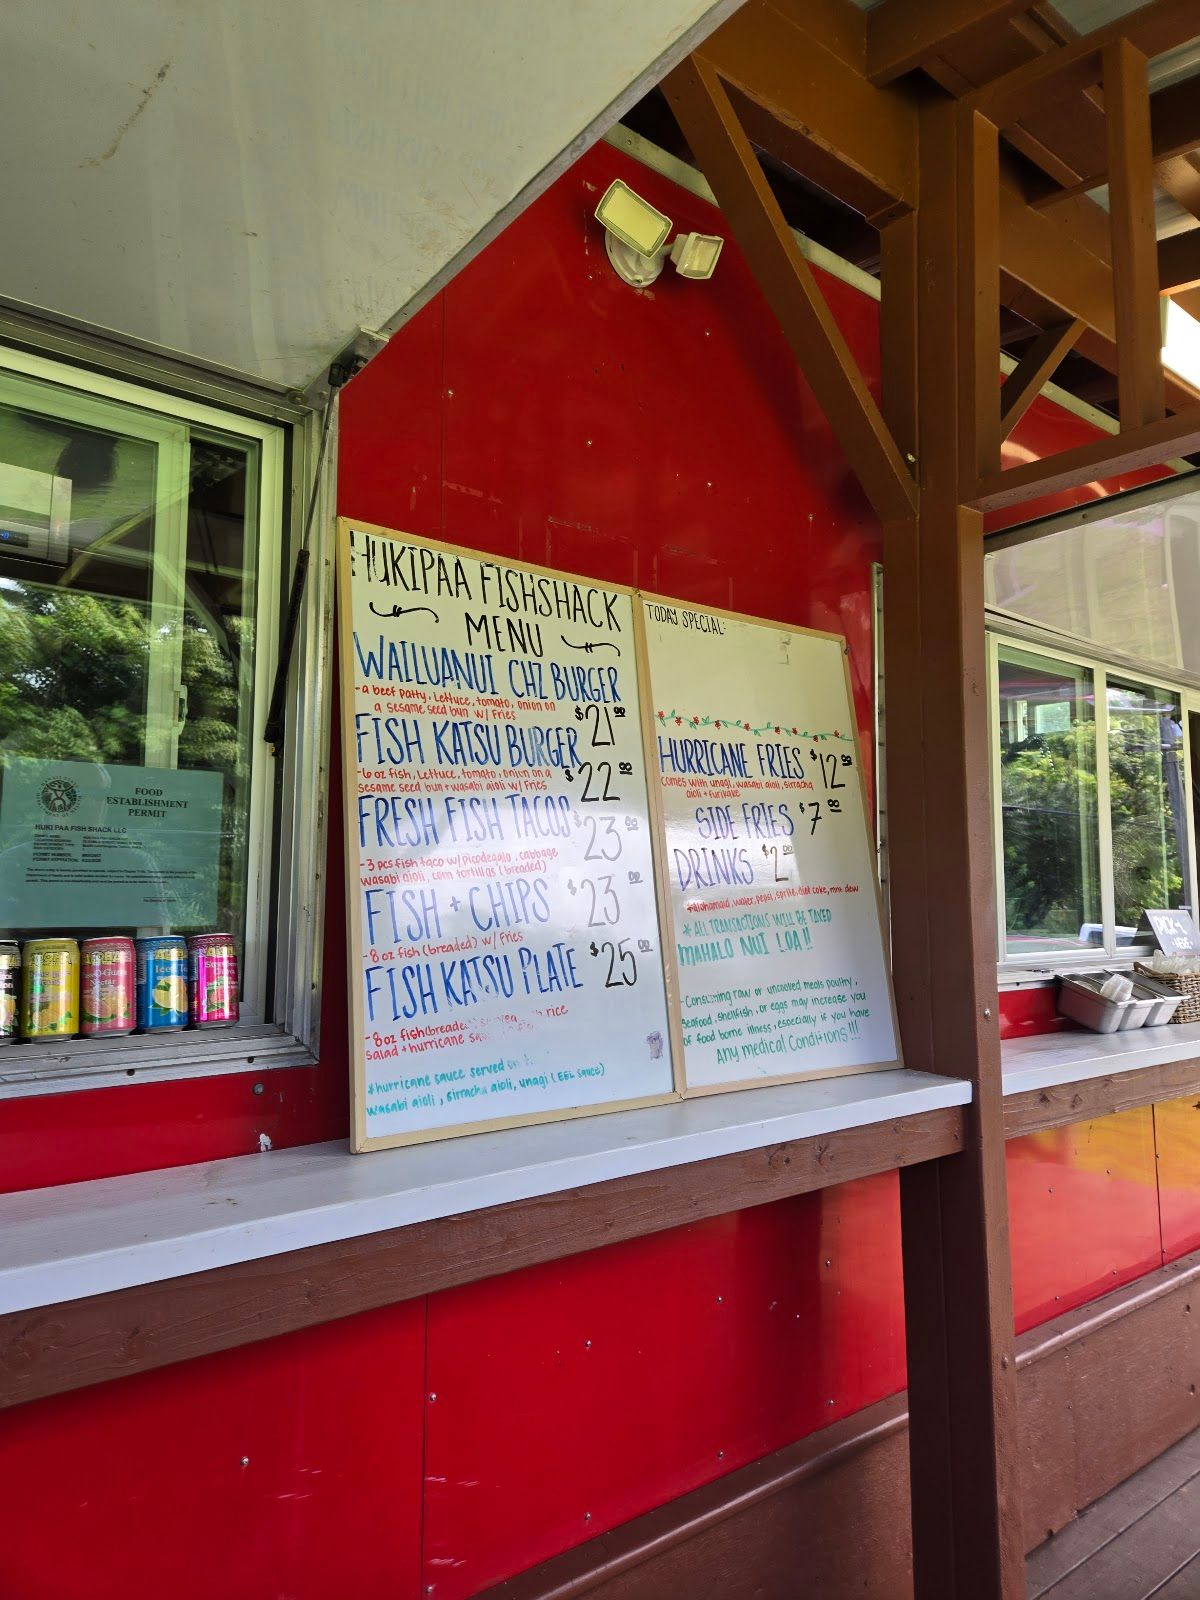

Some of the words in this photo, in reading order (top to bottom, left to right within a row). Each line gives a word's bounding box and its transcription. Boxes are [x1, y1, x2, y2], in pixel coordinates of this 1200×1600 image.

[349, 530, 473, 600] HUKIPAA
[646, 604, 678, 625] TODAY
[682, 610, 727, 635] SPECIAL:
[464, 612, 544, 657] MENU
[352, 631, 500, 695] WAILUANUI
[508, 659, 548, 700] CHZ
[551, 661, 622, 704] BURGER
[372, 685, 396, 696] beef
[476, 696, 514, 709] tomato,
[517, 701, 543, 711] onion
[545, 701, 556, 711] on
[374, 703, 382, 713] a
[387, 702, 423, 714] sesame
[427, 704, 447, 715] seed
[449, 706, 469, 718] bun
[355, 713, 425, 764] FISH
[432, 720, 501, 766] KATSU
[505, 724, 583, 769] BURGER
[658, 736, 753, 779] HURRICANE
[756, 743, 805, 779] FRIES
[358, 782, 396, 793] sesame
[399, 781, 422, 793] seed
[486, 779, 506, 792] aioli
[374, 770, 386, 779] oz
[388, 767, 416, 780] fish,
[503, 768, 531, 779] onion
[532, 769, 542, 778] on
[545, 768, 553, 779] a
[660, 775, 687, 787] comes
[689, 776, 708, 788] with
[736, 779, 763, 790] wasabi
[106, 796, 189, 809] ESTABLISHMENT
[135, 787, 163, 797] FOOD
[686, 789, 702, 799] aioli
[128, 808, 167, 818] PERMIT
[358, 794, 440, 848] FRESH
[444, 796, 504, 842] FISH
[505, 793, 570, 838] TACOS
[695, 804, 739, 840] SIDE
[742, 802, 795, 839] FRIES
[54, 824, 70, 832] PAA
[361, 872, 400, 886] wasabi
[432, 871, 454, 881] corn
[455, 865, 496, 879] tortillas
[499, 859, 547, 876] (breaded)
[377, 861, 393, 871] pcs
[395, 857, 418, 868] fish
[420, 857, 444, 868] taco
[519, 847, 559, 861] cabbage
[673, 847, 754, 891] DRINKS
[365, 888, 443, 946] FISH
[449, 896, 461, 912] +
[468, 878, 551, 931] CHIPS
[694, 920, 709, 936] ALL
[709, 912, 771, 935] TRANSACTIONS
[772, 911, 796, 928] WILL
[795, 910, 808, 925] BE
[807, 908, 832, 923] TAXED
[381, 952, 395, 961] oz
[398, 946, 420, 959] fish
[422, 936, 478, 957] (breaded)
[677, 937, 735, 967] MAHALO
[739, 931, 770, 956] NUI
[365, 965, 439, 1021] FISH
[440, 954, 515, 1007] KATSU
[518, 942, 584, 995] PLATE
[733, 987, 751, 1000] raw
[755, 986, 763, 997] or
[767, 979, 802, 995] uncooked
[545, 1004, 569, 1018] rice
[759, 1004, 767, 1014] or
[770, 1000, 789, 1014] eggs
[791, 996, 809, 1011] may
[811, 993, 848, 1006] increase
[850, 991, 867, 1004] you
[384, 1034, 397, 1044] oz
[682, 1034, 692, 1047] of
[696, 1028, 716, 1044] food
[777, 1014, 817, 1029] especially
[820, 1012, 828, 1022] if
[831, 1011, 847, 1025] you
[848, 1007, 870, 1018] have
[408, 1033, 465, 1054] hurricane
[716, 1045, 740, 1065] Any
[741, 1033, 787, 1058] medical
[434, 1068, 466, 1085] sauce
[469, 1058, 505, 1078] served
[367, 1097, 408, 1117] wasabi
[518, 1072, 549, 1090] unagi
[576, 1062, 606, 1079] sauce)
